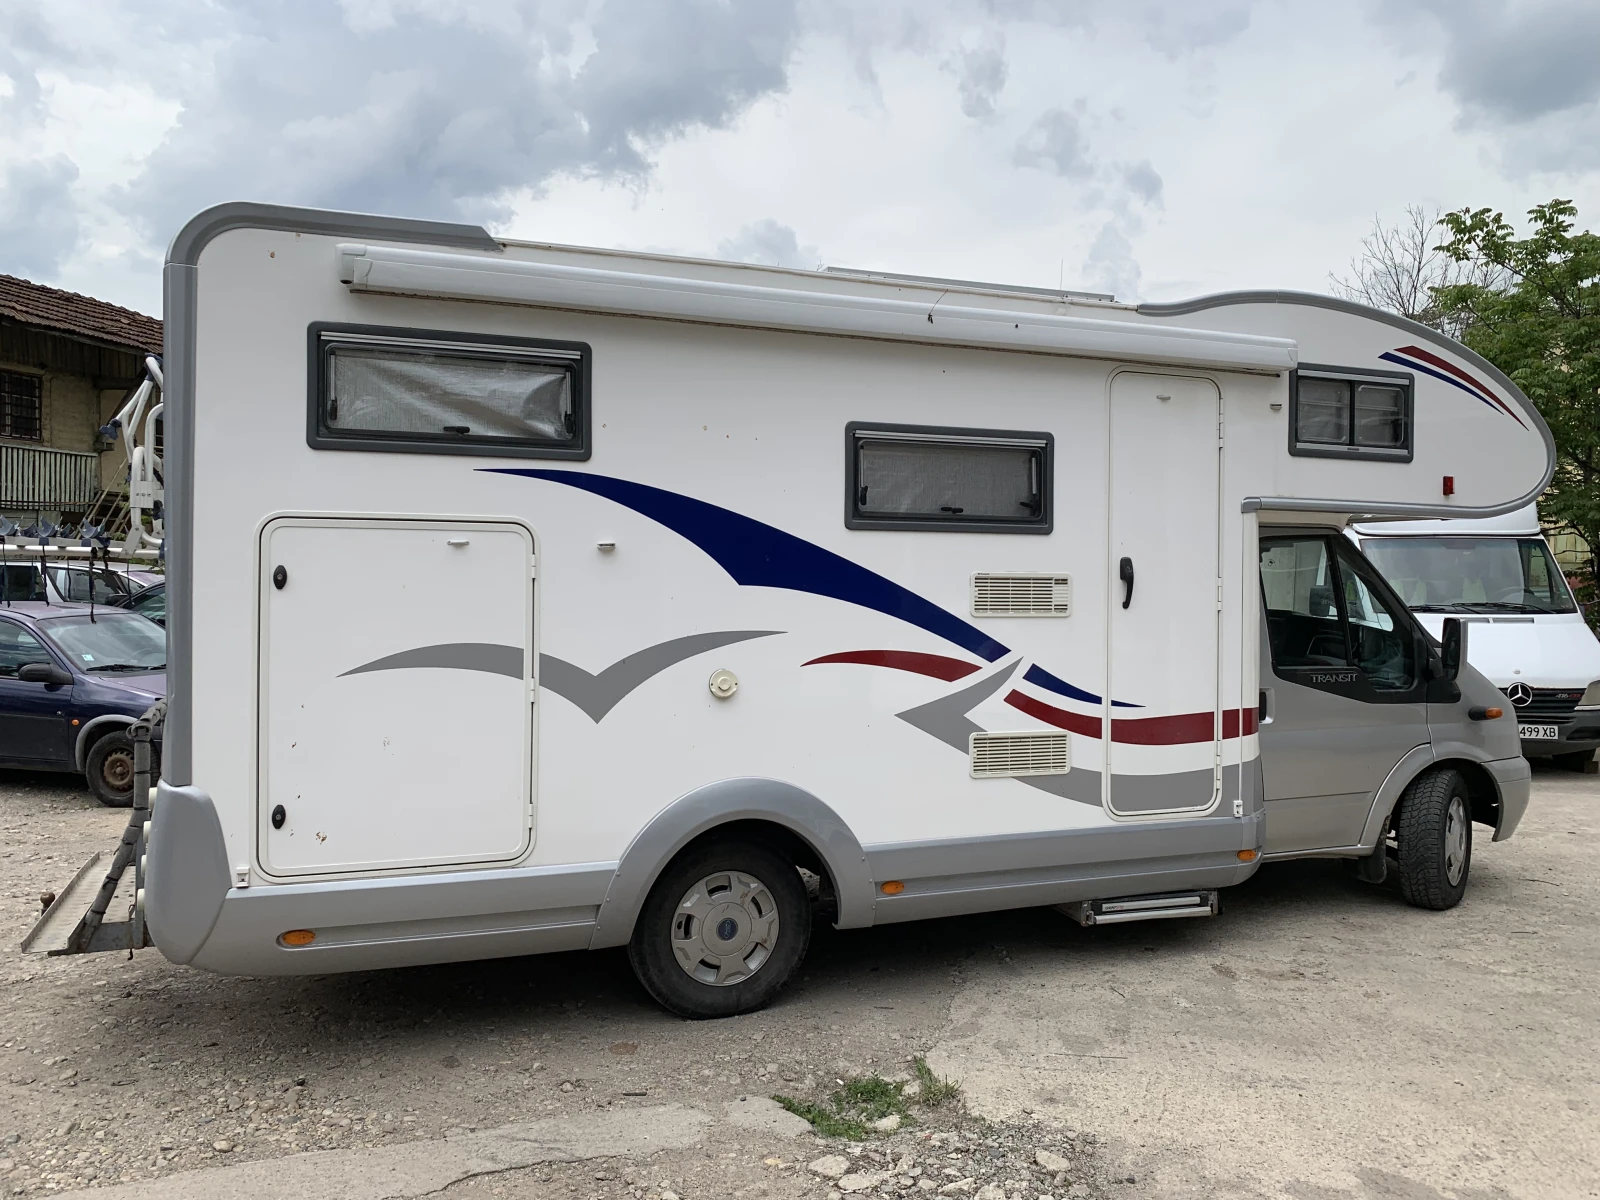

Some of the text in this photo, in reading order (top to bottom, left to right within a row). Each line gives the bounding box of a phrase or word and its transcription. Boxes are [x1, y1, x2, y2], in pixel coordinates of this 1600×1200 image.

[1310, 673, 1358, 683] TRANSIT
[1519, 726, 1557, 738] 499 XB
